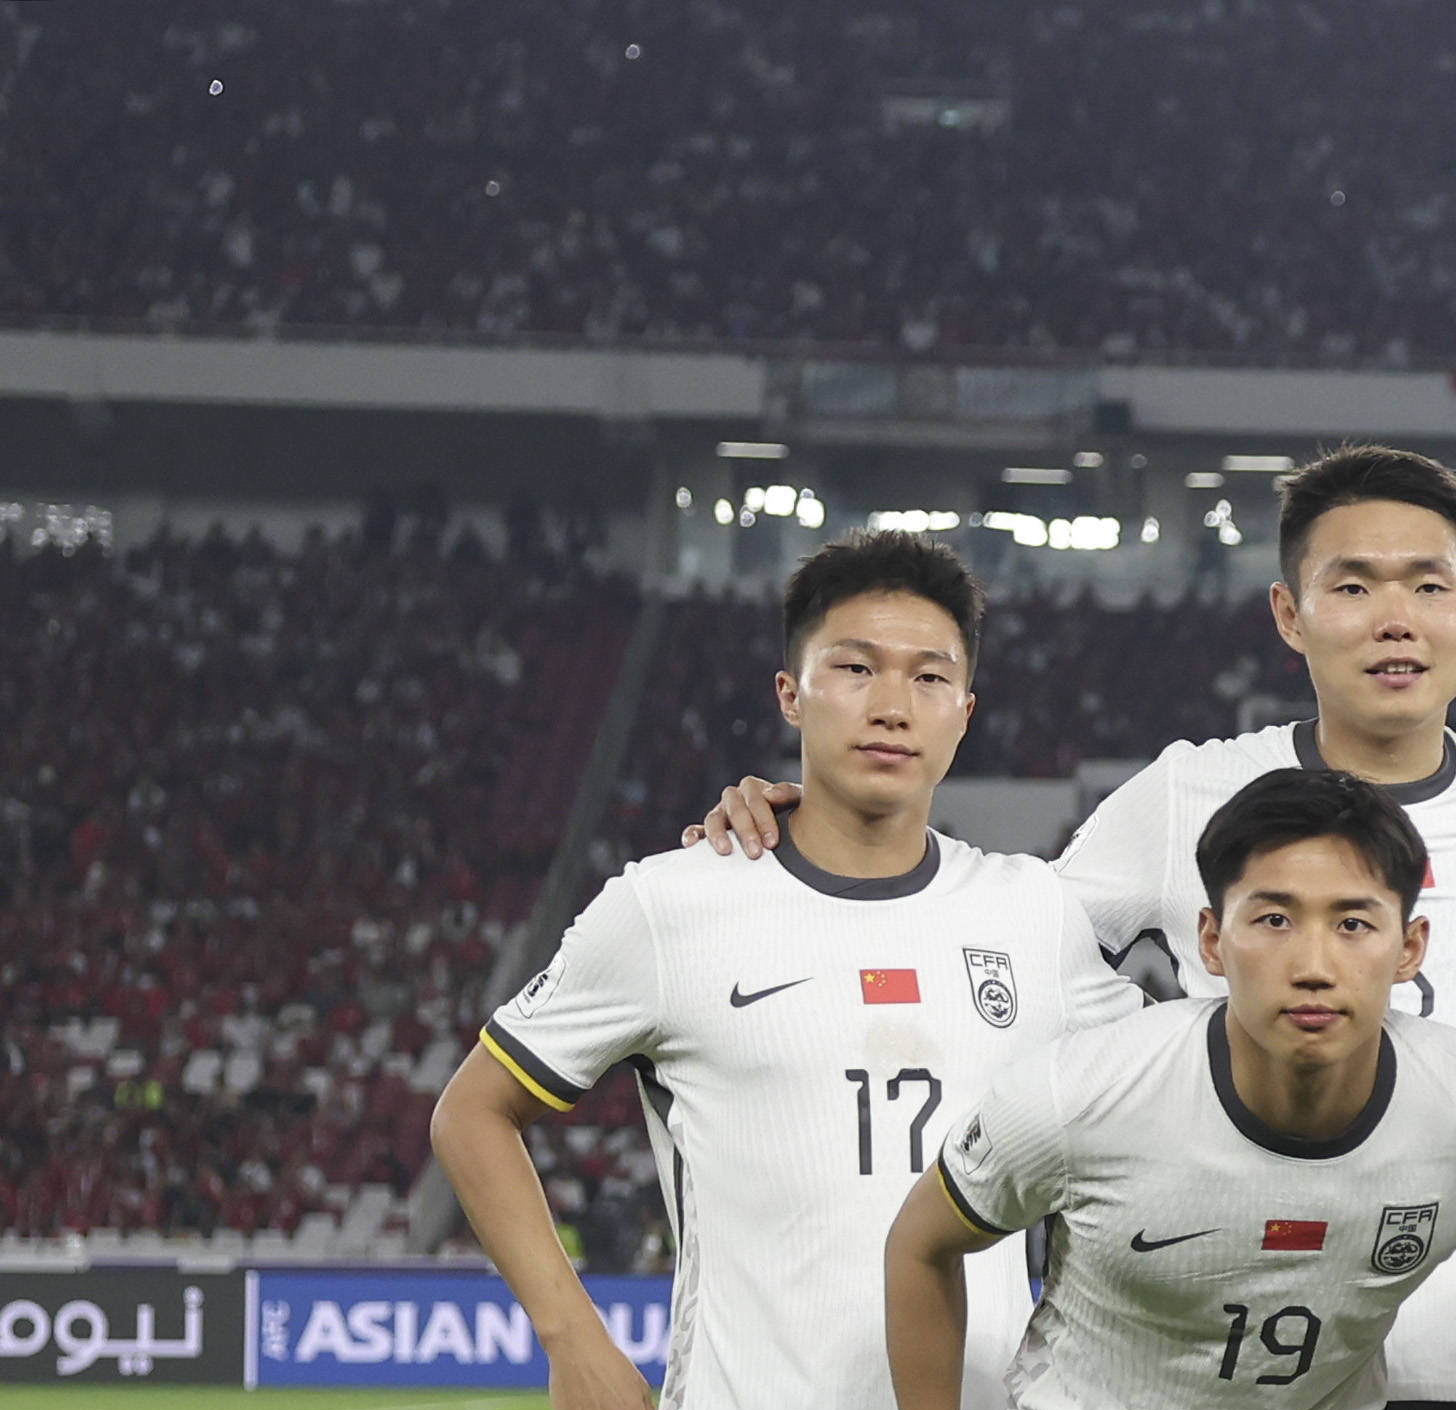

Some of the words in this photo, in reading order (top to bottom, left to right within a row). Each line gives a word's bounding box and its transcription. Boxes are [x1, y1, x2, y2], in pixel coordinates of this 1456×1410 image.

[845, 1068, 942, 1175] 17
[1386, 1209, 1432, 1226] CFA
[294, 1300, 533, 1364] ASIAN
[1218, 1303, 1322, 1386] 19
